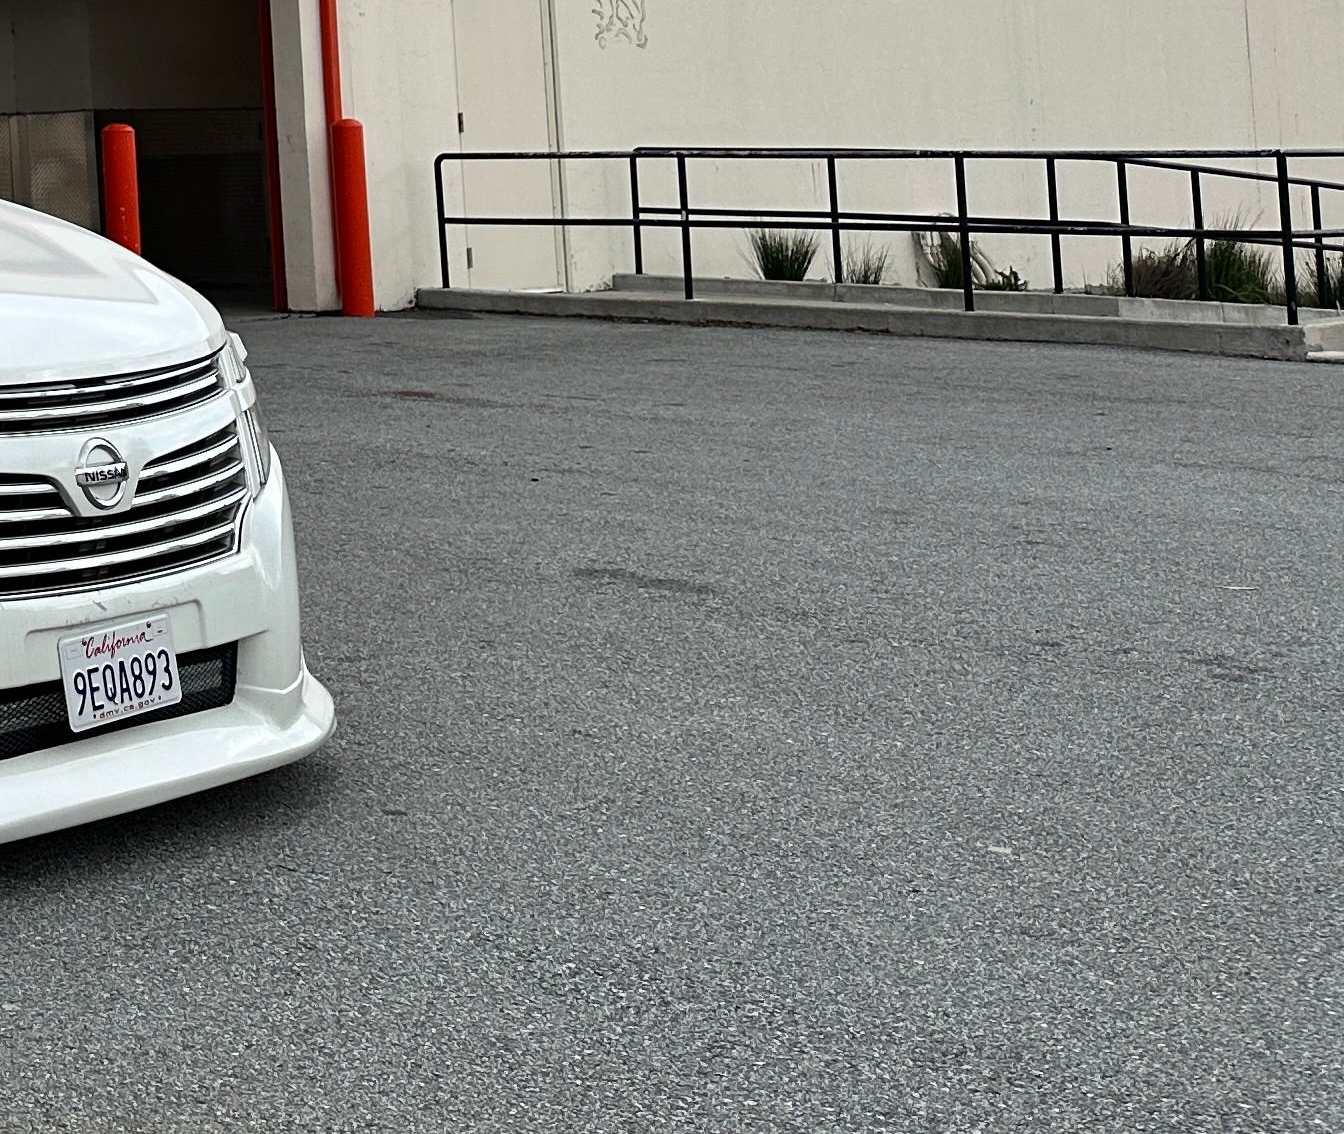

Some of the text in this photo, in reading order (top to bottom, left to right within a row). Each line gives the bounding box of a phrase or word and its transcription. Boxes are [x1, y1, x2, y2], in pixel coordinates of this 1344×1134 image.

[84, 466, 127, 483] NISSAN
[84, 630, 153, 659] California
[73, 648, 173, 716] 9EQA893
[99, 697, 156, 720] dmv.ca.gov
